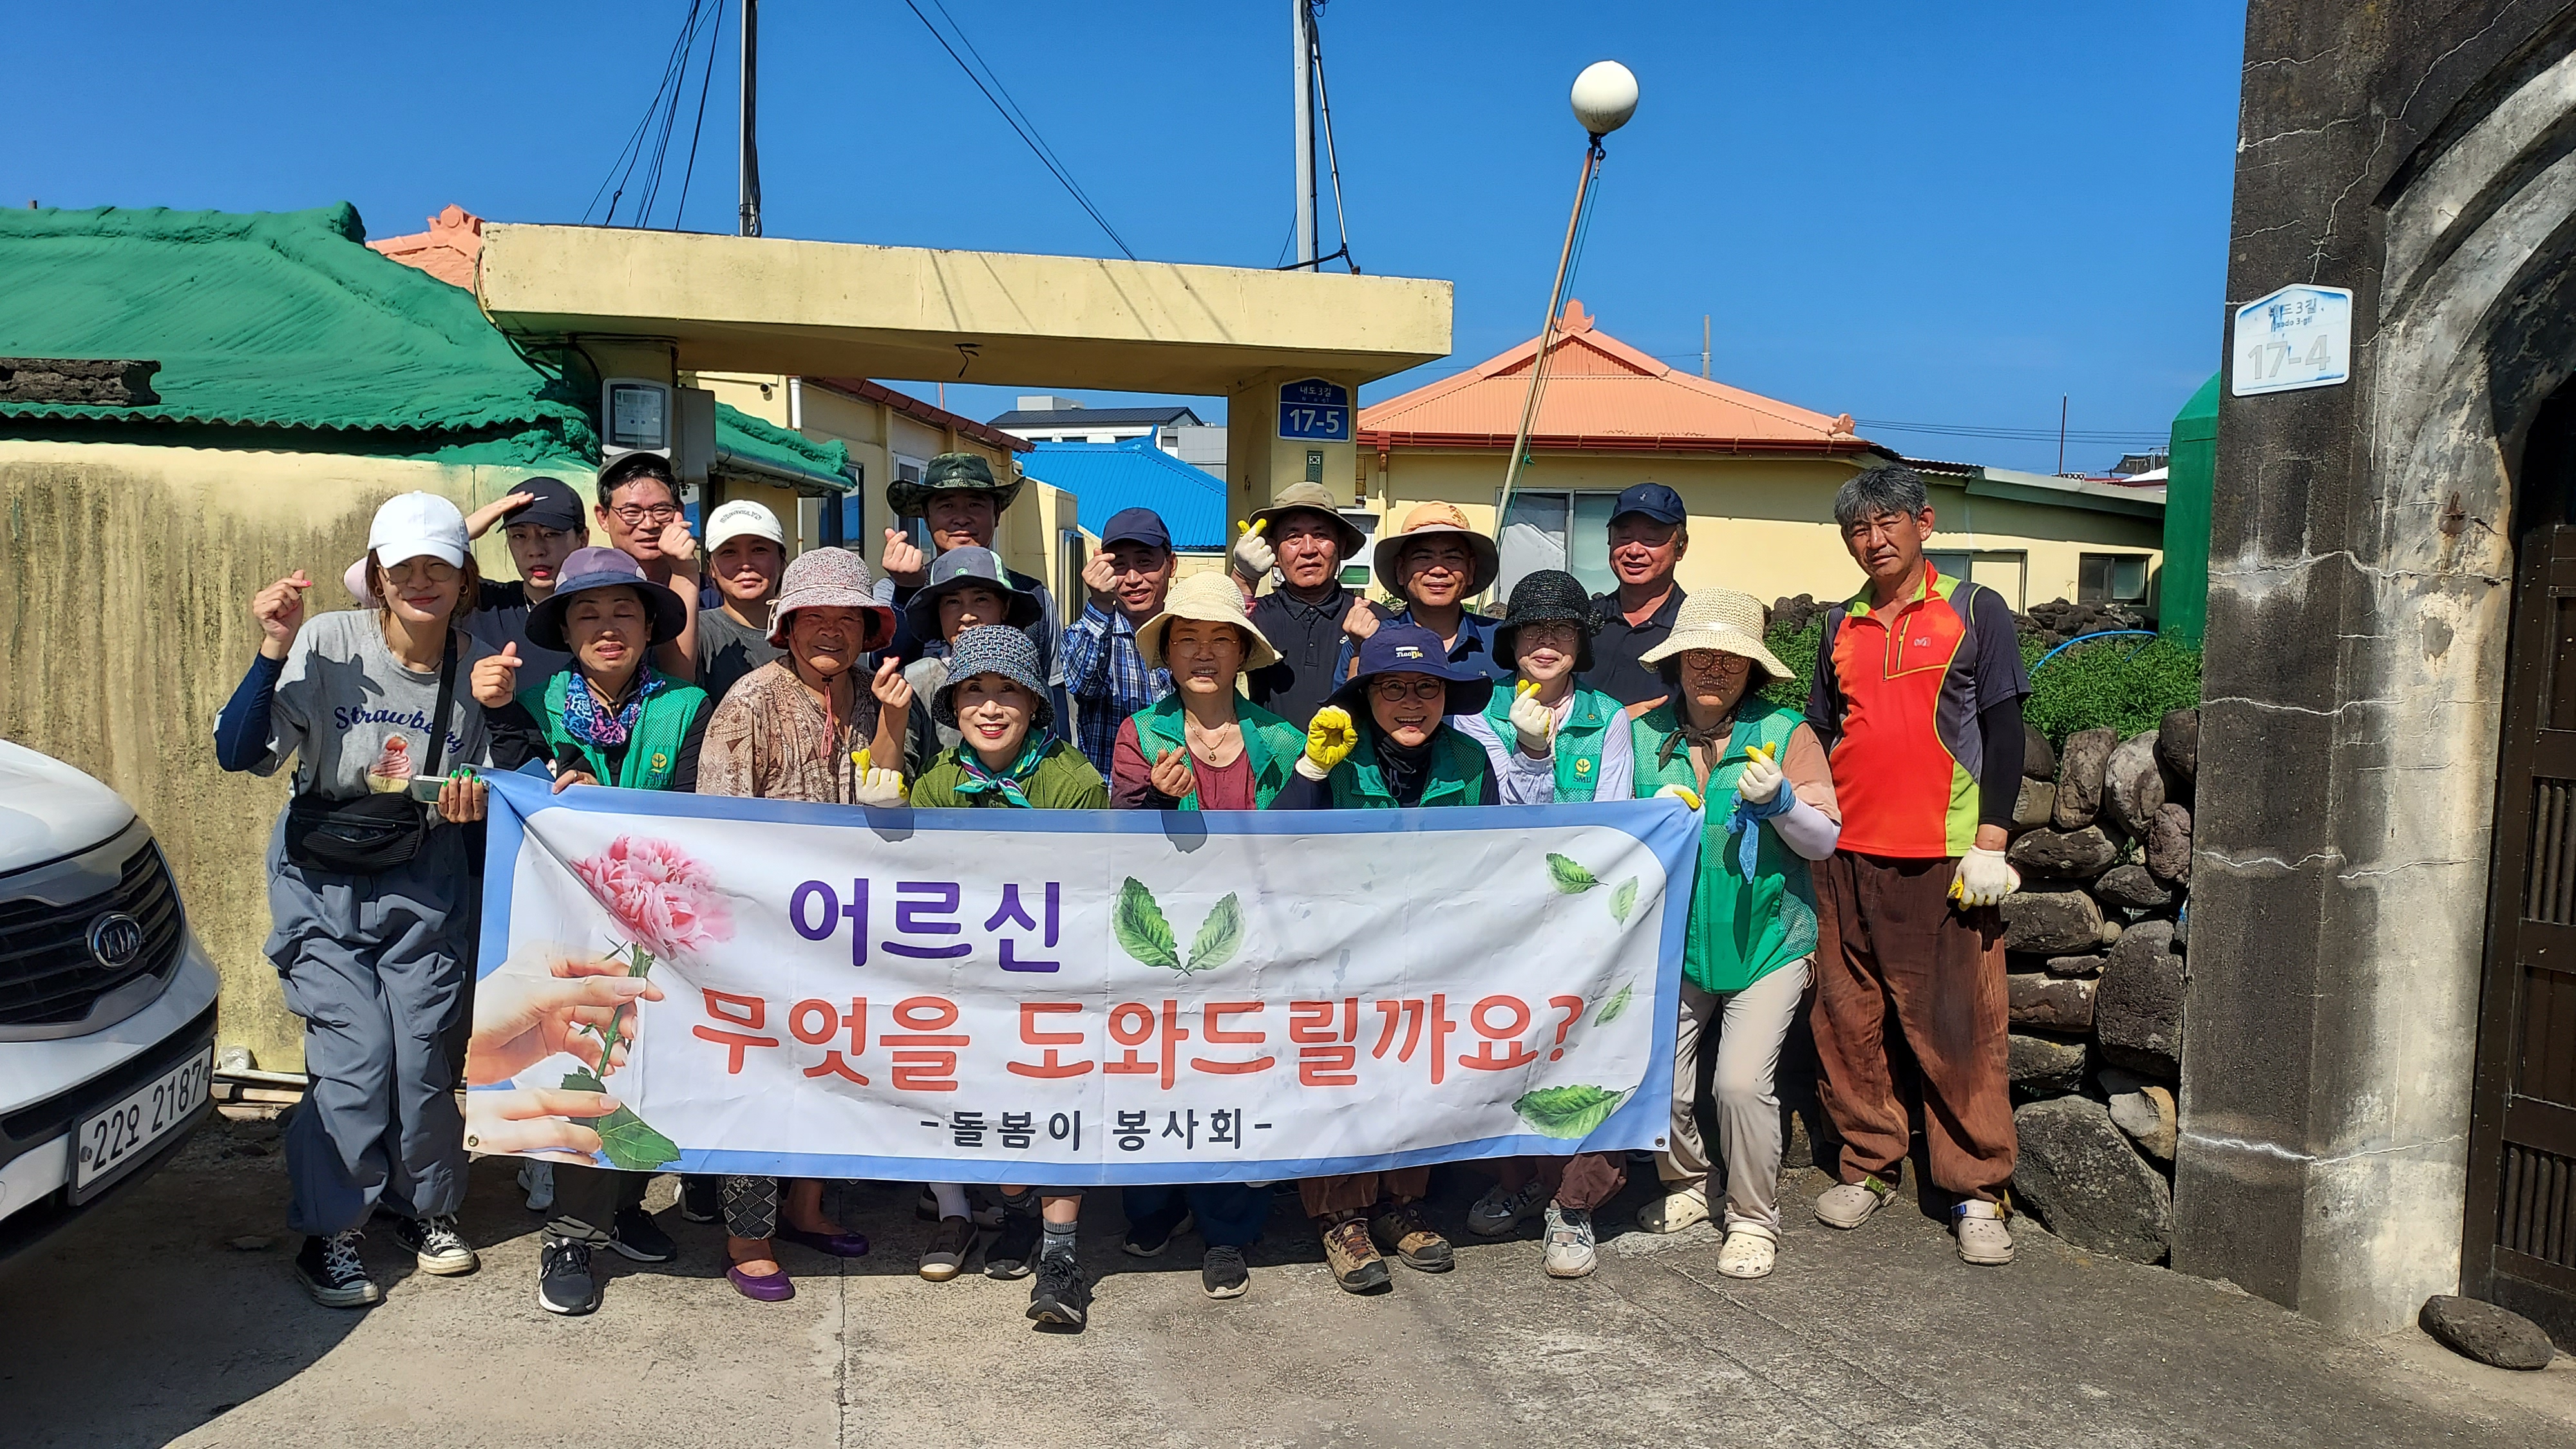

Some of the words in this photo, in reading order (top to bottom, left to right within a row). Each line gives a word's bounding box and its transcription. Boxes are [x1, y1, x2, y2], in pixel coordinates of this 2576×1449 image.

[2248, 334, 2331, 380] 17-4
[1300, 386, 1331, 397] 내도3길
[1289, 409, 1339, 433] 17-5
[334, 706, 464, 753] Strawbery
[102, 925, 138, 959] KIA
[790, 878, 1061, 973] 어르신
[692, 987, 971, 1091] 무엇을
[1006, 993, 1584, 1090] 도와드릴까요?
[92, 1104, 140, 1172] 22오
[151, 1057, 203, 1133] 2187
